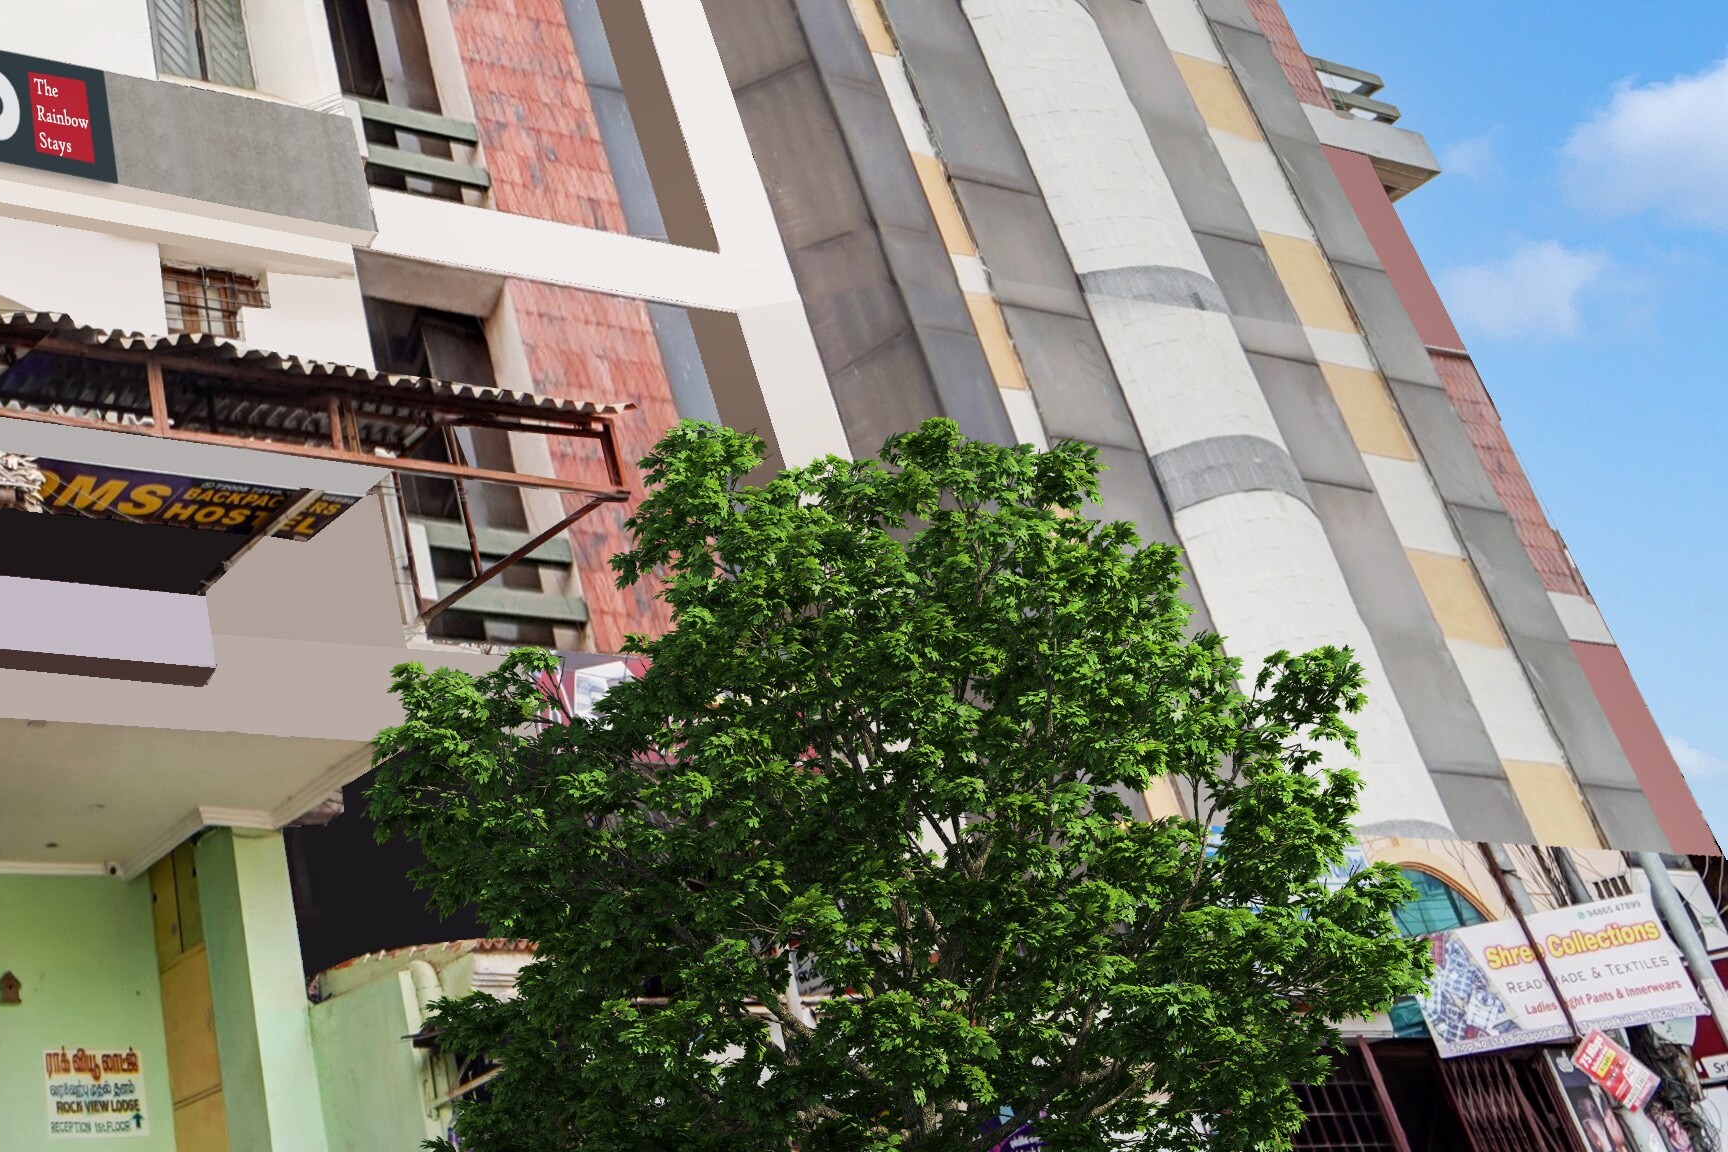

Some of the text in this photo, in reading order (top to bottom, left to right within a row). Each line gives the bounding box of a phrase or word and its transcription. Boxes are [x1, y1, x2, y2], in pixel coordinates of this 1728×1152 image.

[34, 78, 59, 97] The
[36, 105, 89, 129] Rainbow
[39, 132, 72, 156] Stays
[183, 487, 341, 515] BACKPACRS
[1484, 921, 1661, 969] Shre Collections
[1604, 956, 1670, 976] TEXTILES
[1525, 1001, 1558, 1015] Ladies
[1585, 991, 1615, 1005] Pants
[1625, 979, 1682, 997] Innerwears
[56, 1099, 140, 1114] ROCK VIEW LODGE
[50, 1121, 92, 1133] RECEPTION
